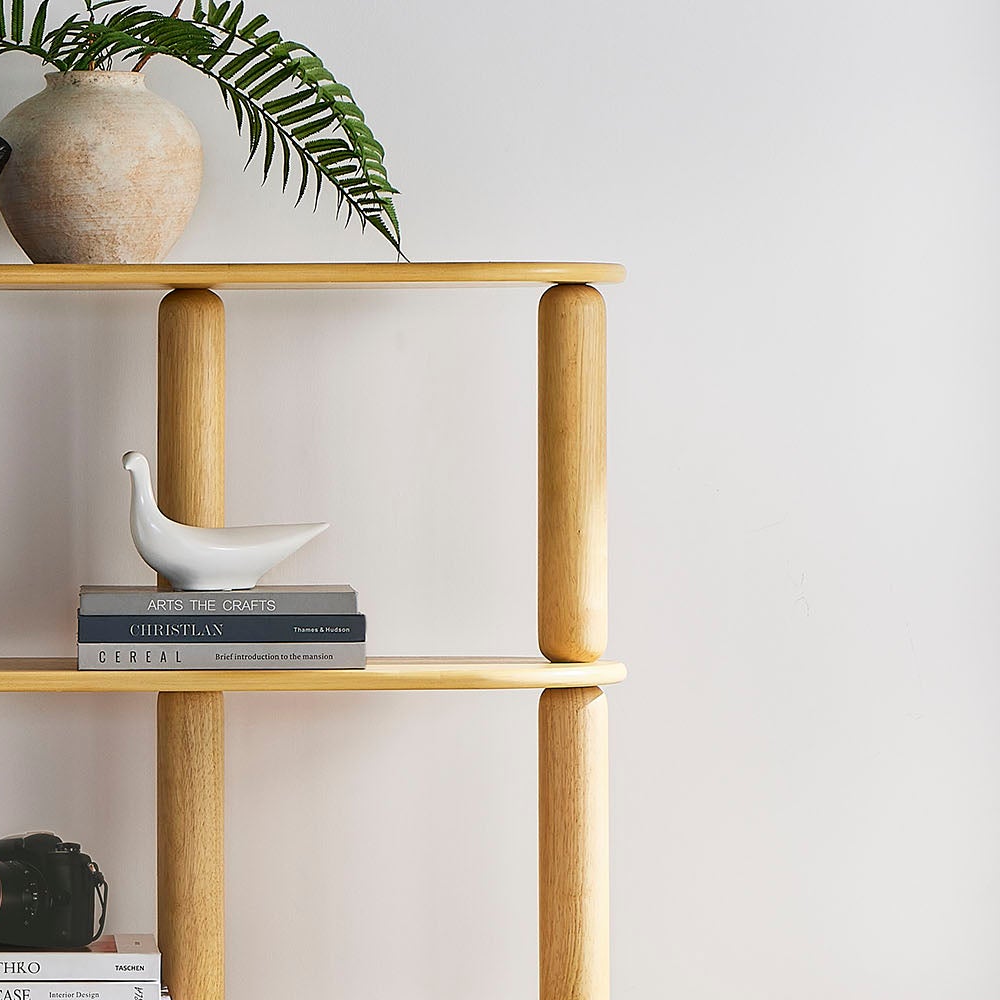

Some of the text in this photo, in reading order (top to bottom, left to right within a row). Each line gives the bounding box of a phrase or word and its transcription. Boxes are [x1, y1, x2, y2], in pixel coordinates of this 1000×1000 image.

[147, 600, 276, 611] ARTS THE CRAFTS
[99, 651, 182, 663] CEREAL
[215, 652, 333, 661] Brief introduction to the mansion
[76, 991, 99, 999] Design
